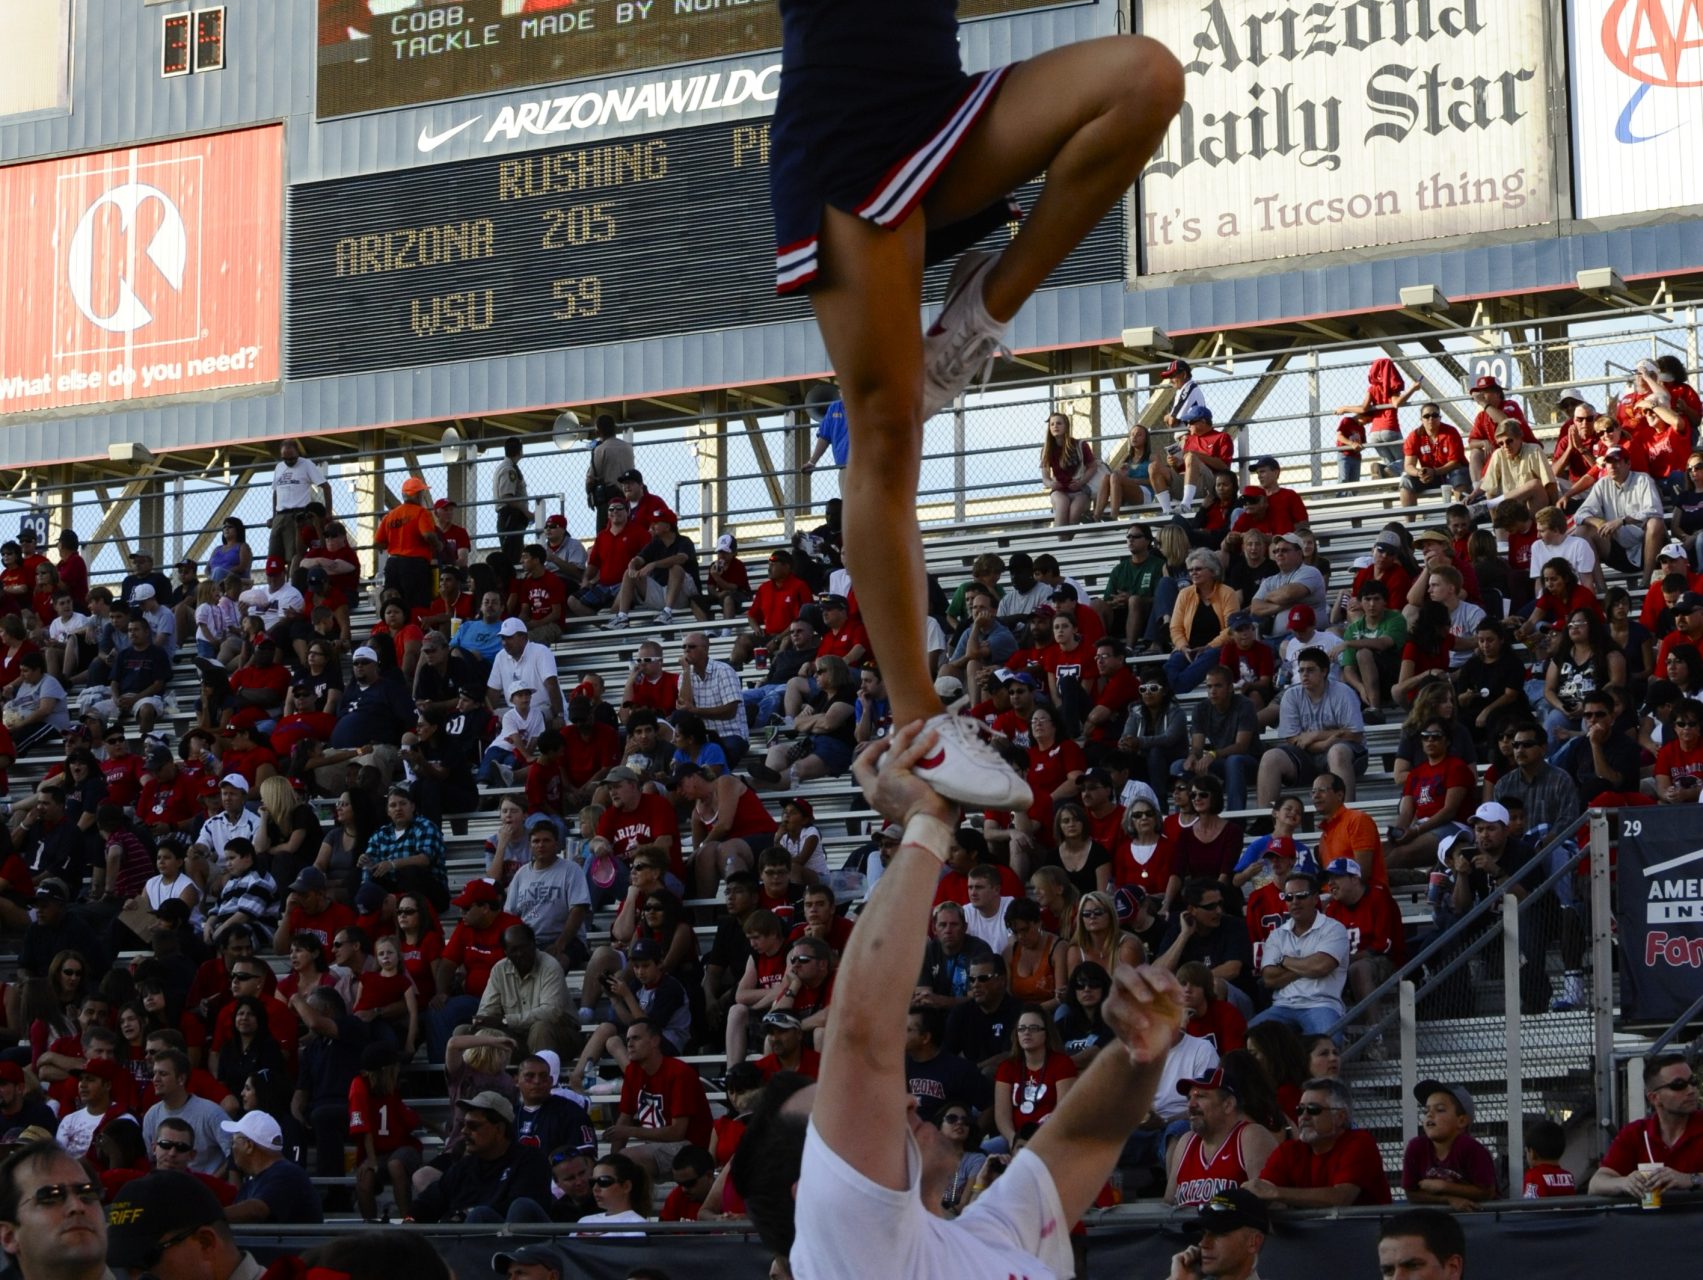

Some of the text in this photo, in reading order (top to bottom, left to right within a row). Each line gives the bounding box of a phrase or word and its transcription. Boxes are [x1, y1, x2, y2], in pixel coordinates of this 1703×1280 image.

[392, 24, 500, 60] TACKLE
[520, 8, 595, 39] MADE
[616, 0, 653, 23] BY
[1364, 62, 1537, 148] Star
[499, 139, 667, 201] RUSHING
[1145, 168, 1537, 247] It's a Tucson thing.
[336, 201, 616, 277] ARIZONA 205
[411, 276, 600, 336] WSU 59
[0, 346, 258, 400] What else do you need?
[1622, 819, 1643, 837] 29
[1647, 878, 1703, 900] AME
[1664, 905, 1703, 919] IN
[377, 1104, 390, 1136] 1
